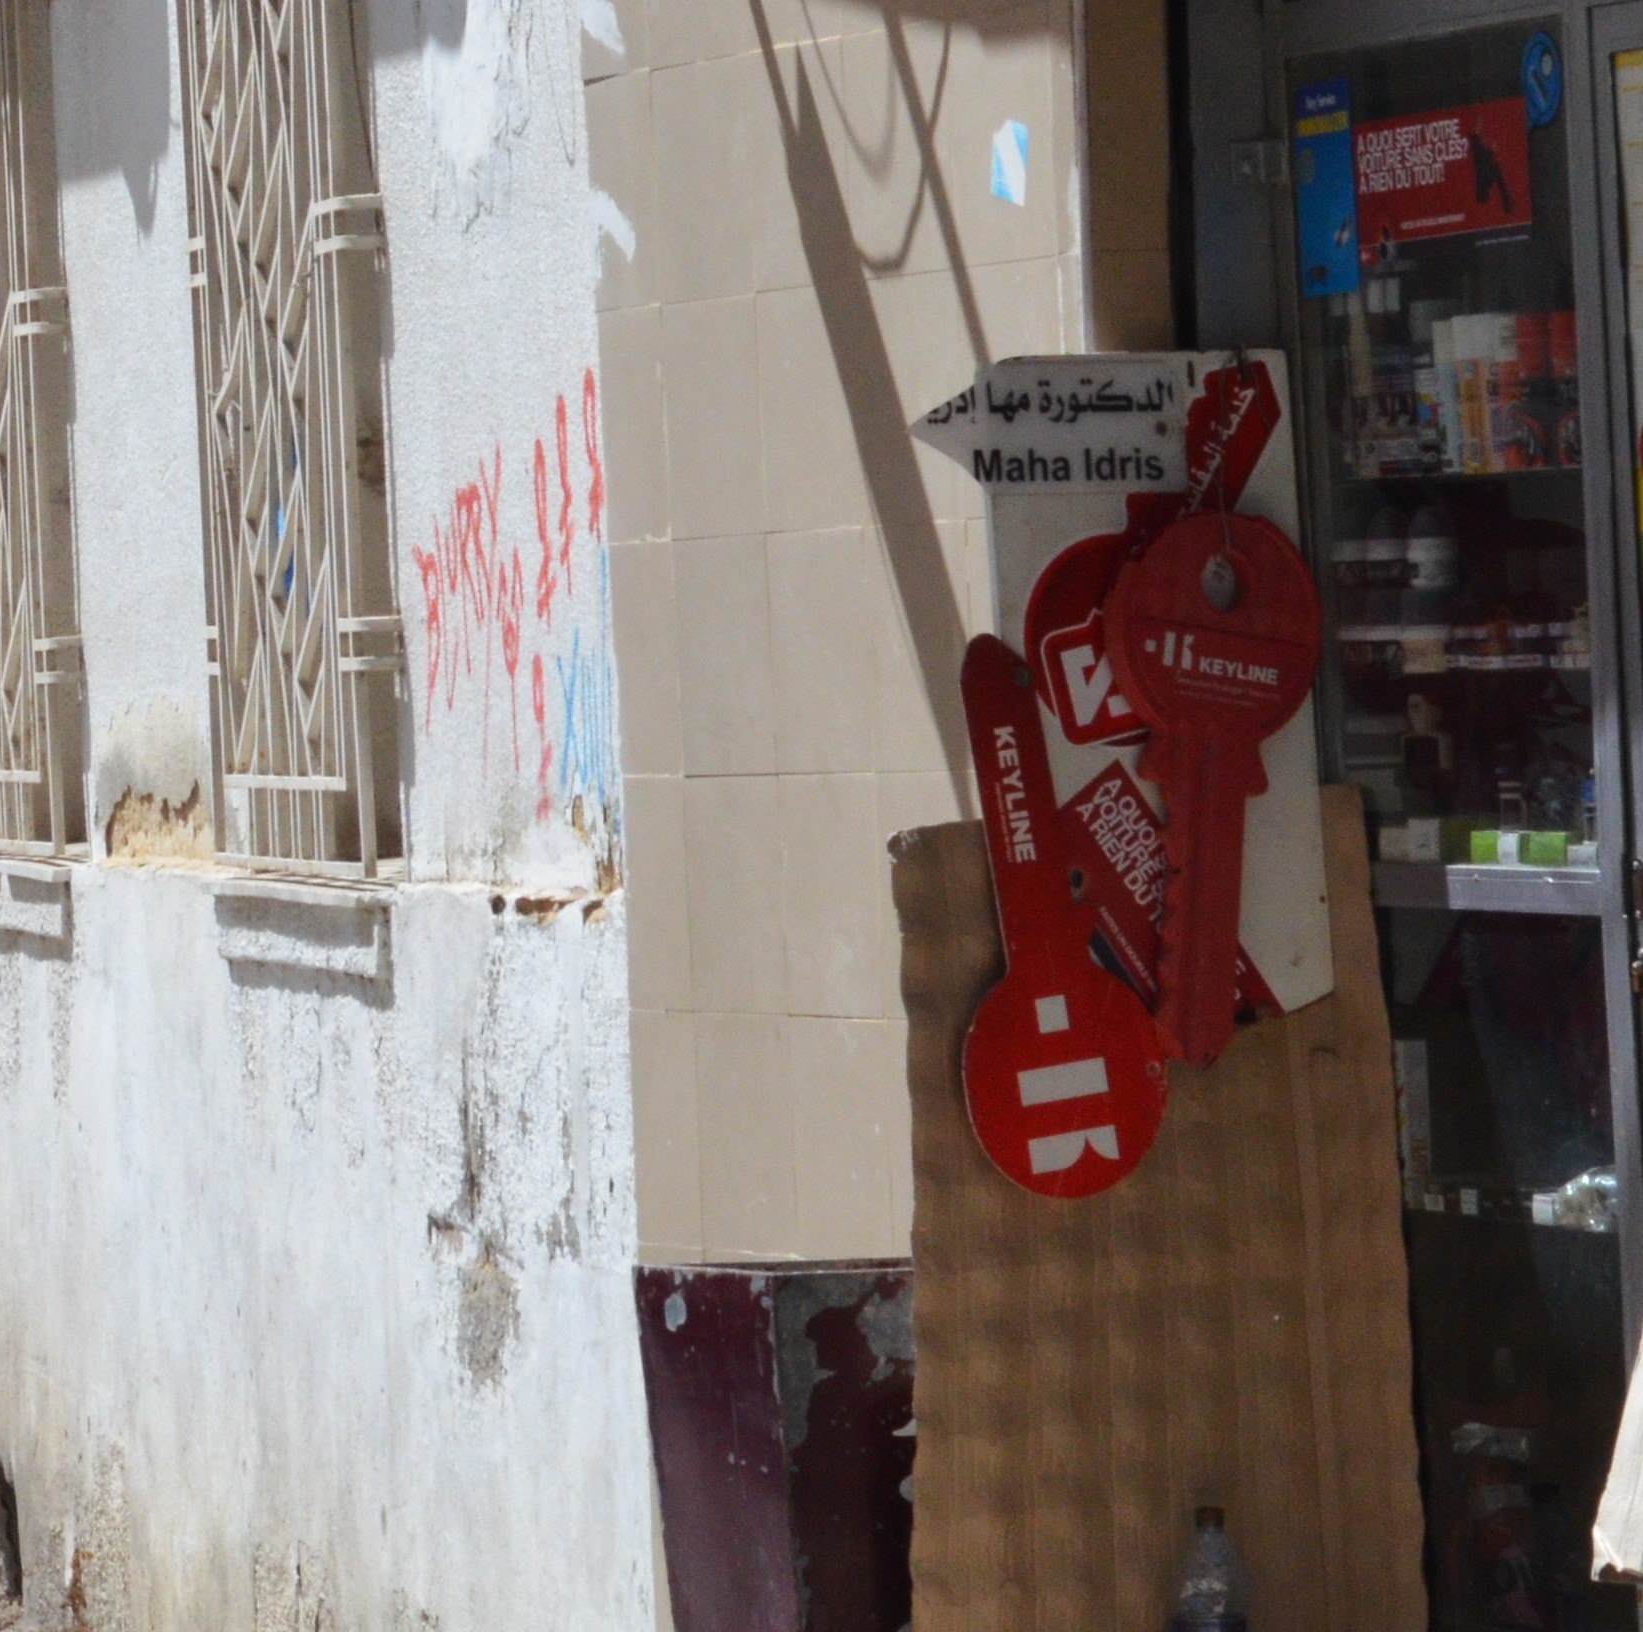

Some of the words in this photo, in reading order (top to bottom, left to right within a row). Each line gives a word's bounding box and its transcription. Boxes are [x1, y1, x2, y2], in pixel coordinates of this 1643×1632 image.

[1366, 130, 1394, 152] QUOI
[1395, 124, 1422, 148] SERT
[1424, 118, 1460, 142] VOTRE
[1358, 149, 1403, 174] VOITURE
[1404, 144, 1433, 166] SANS
[1369, 171, 1394, 192] RIEN
[1396, 168, 1411, 188] DU
[987, 381, 1030, 423] مها
[1038, 378, 1173, 424] الدكتورة
[973, 448, 1070, 482] Maha
[1085, 447, 1164, 482] Idris
[1198, 655, 1279, 686] KEYLINE
[993, 726, 1037, 864] KEYLINE
[1085, 785, 1164, 883] VOITURE
[1112, 792, 1165, 855] QUOI
[1086, 818, 1134, 875] RIEN
[1121, 870, 1156, 909] DU
